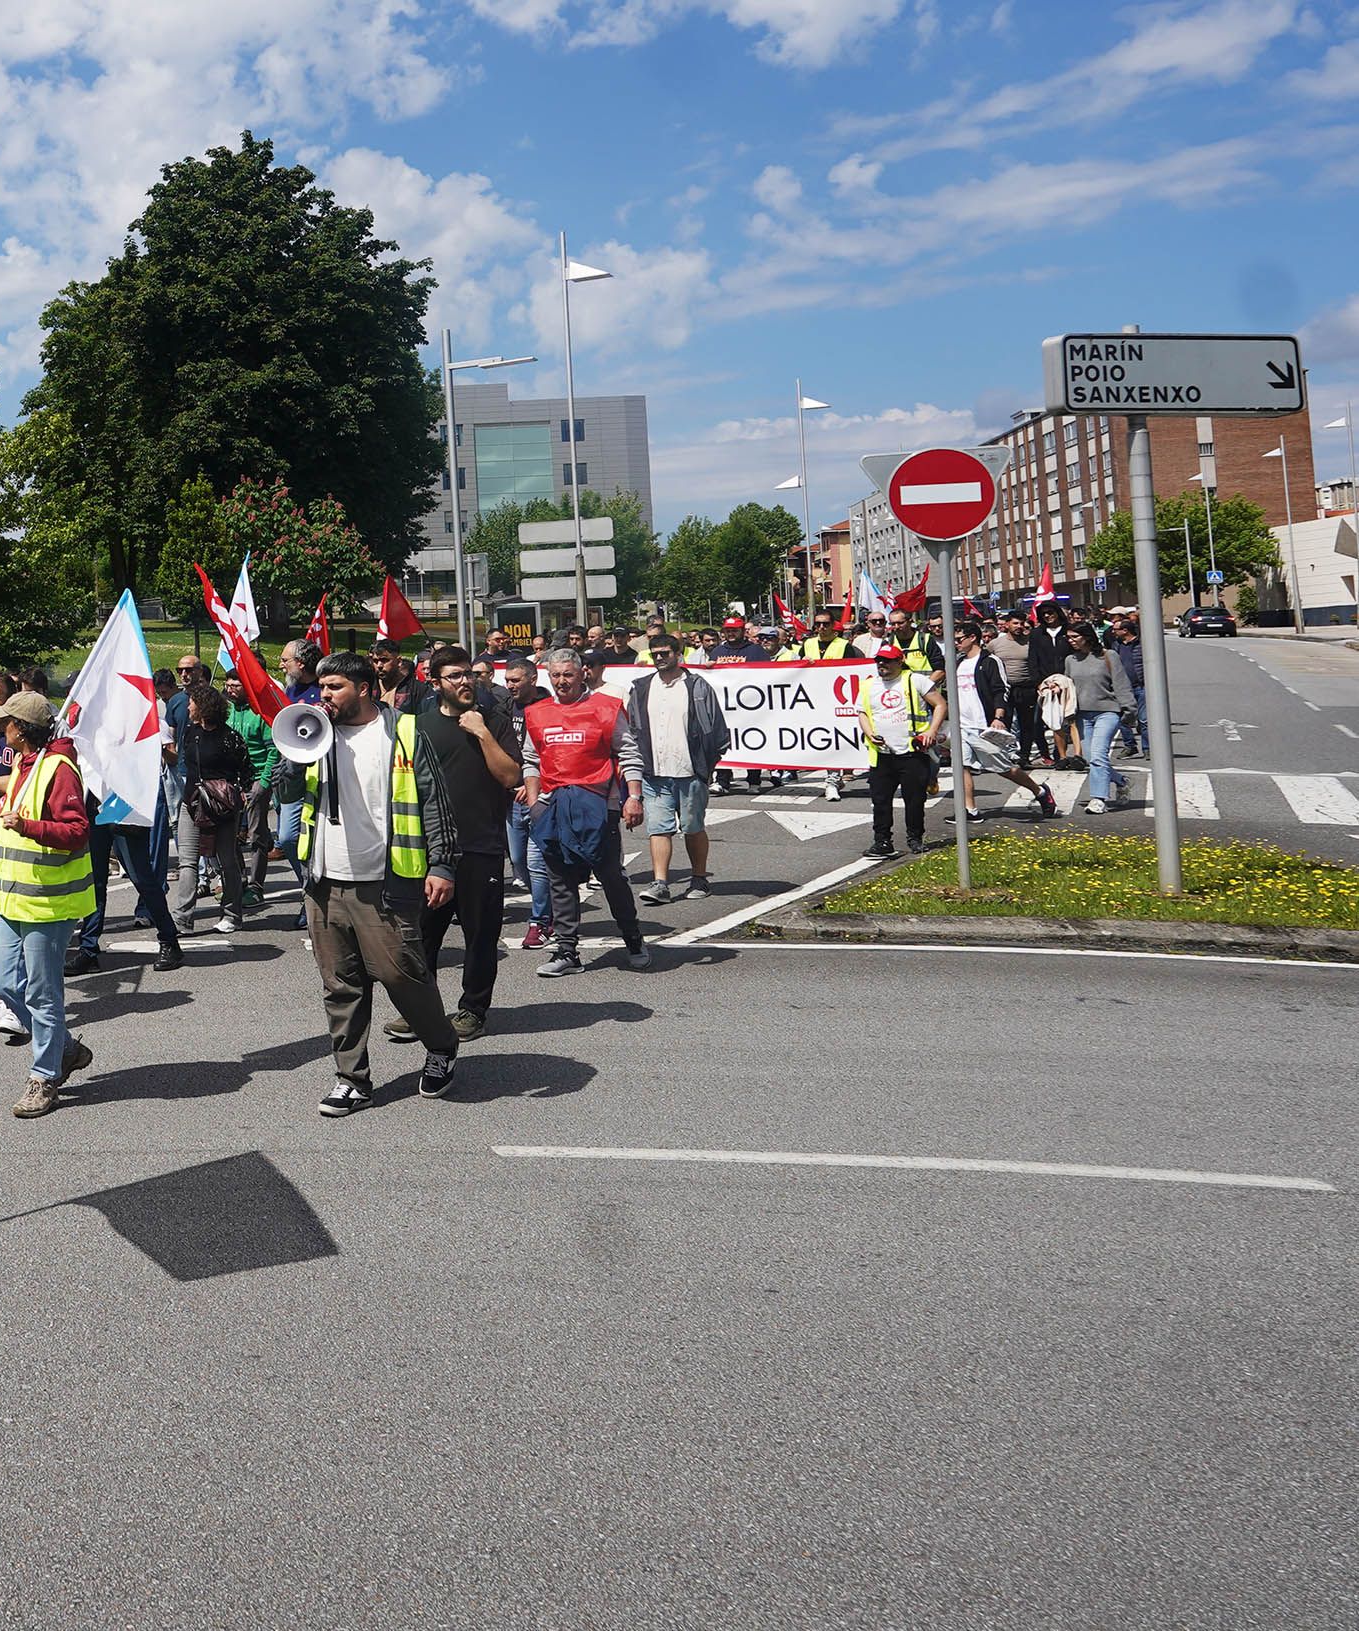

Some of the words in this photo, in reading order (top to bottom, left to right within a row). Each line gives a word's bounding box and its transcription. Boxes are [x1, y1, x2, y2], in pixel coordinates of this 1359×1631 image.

[1069, 341, 1143, 361] MARÍN
[1071, 365, 1125, 382] POIO
[1073, 386, 1201, 403] SANXENXO
[1096, 577, 1104, 585] P
[504, 624, 531, 638] NON
[723, 683, 815, 711] LOITA
[778, 727, 866, 751] DIGN
